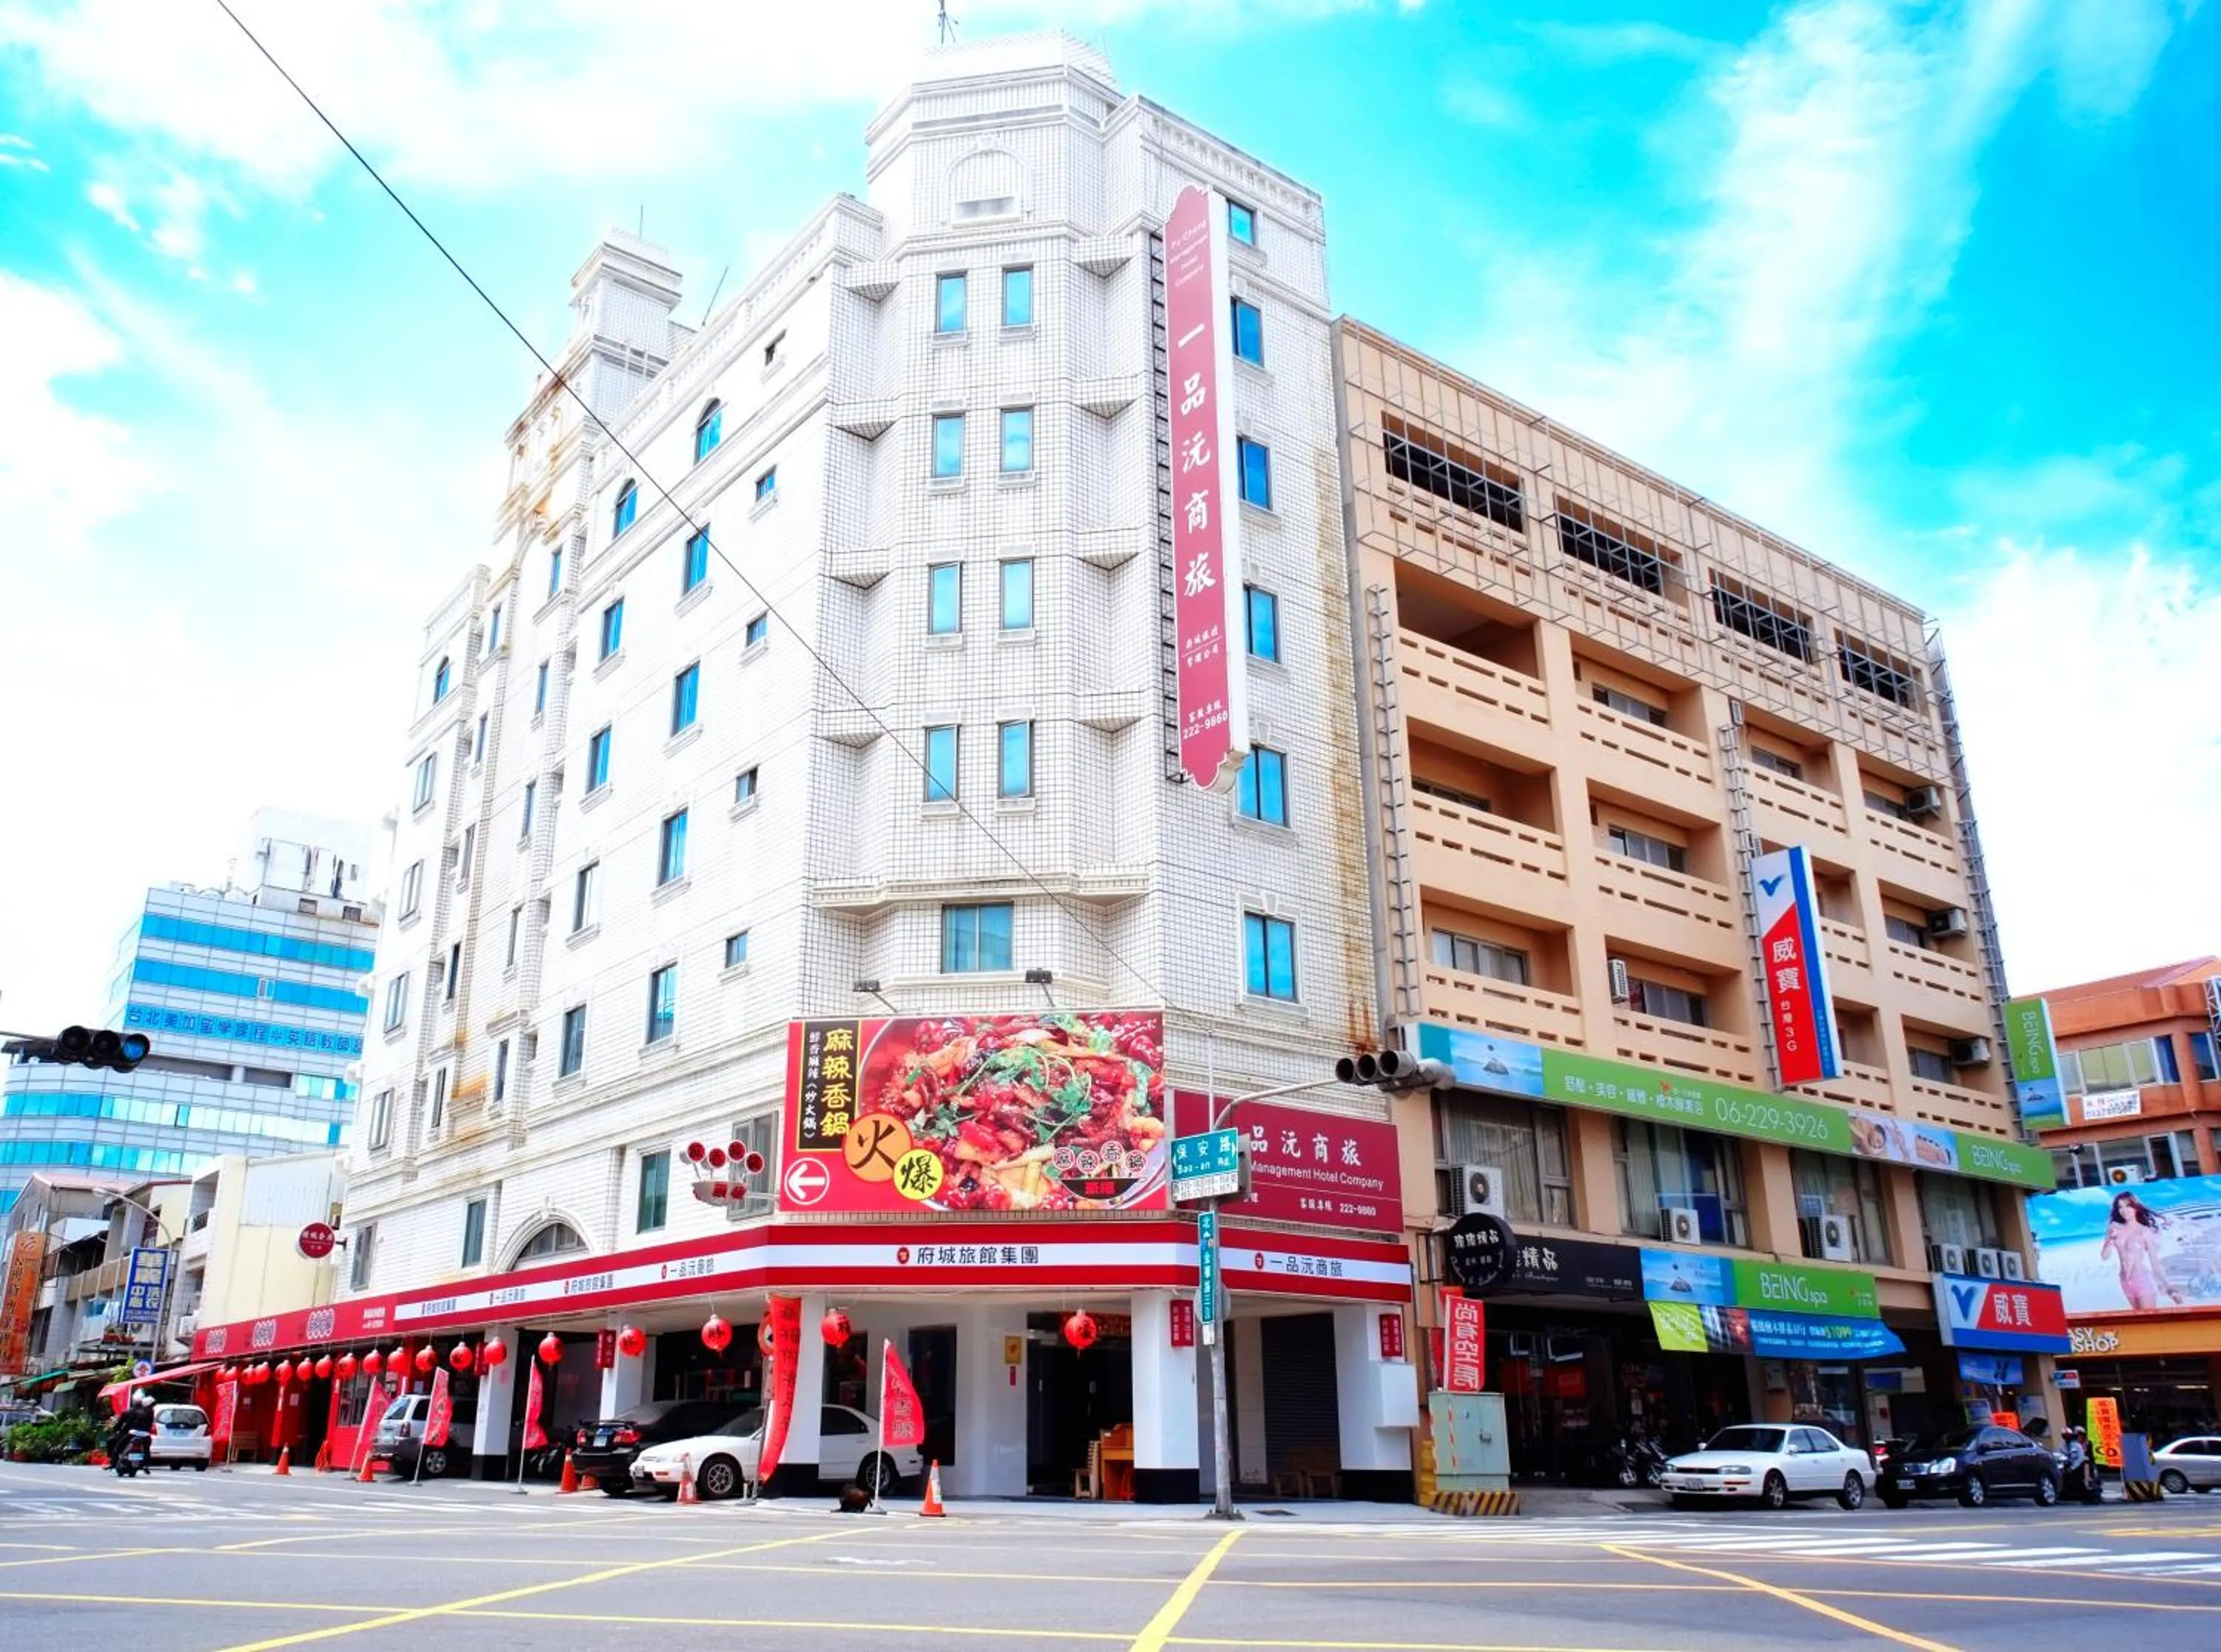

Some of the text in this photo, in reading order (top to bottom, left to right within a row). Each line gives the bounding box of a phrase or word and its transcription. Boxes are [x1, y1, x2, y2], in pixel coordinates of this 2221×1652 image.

[1179, 323, 1217, 597] 一品沅商旅
[1183, 711, 1228, 740] 222-9860
[820, 1028, 854, 1137] 麻辣香鍋
[1715, 1097, 1829, 1140] 06-229-3926
[1177, 1135, 1230, 1161] 保安路
[1313, 1169, 1339, 1183] Hotel
[1340, 1172, 1384, 1192] Company
[917, 1246, 1039, 1265] 府城旅館集團
[1270, 1255, 1343, 1277] 一品沅商旅
[1760, 1272, 1828, 1308] BEING spa
[2075, 1337, 2119, 1352] SHOP
